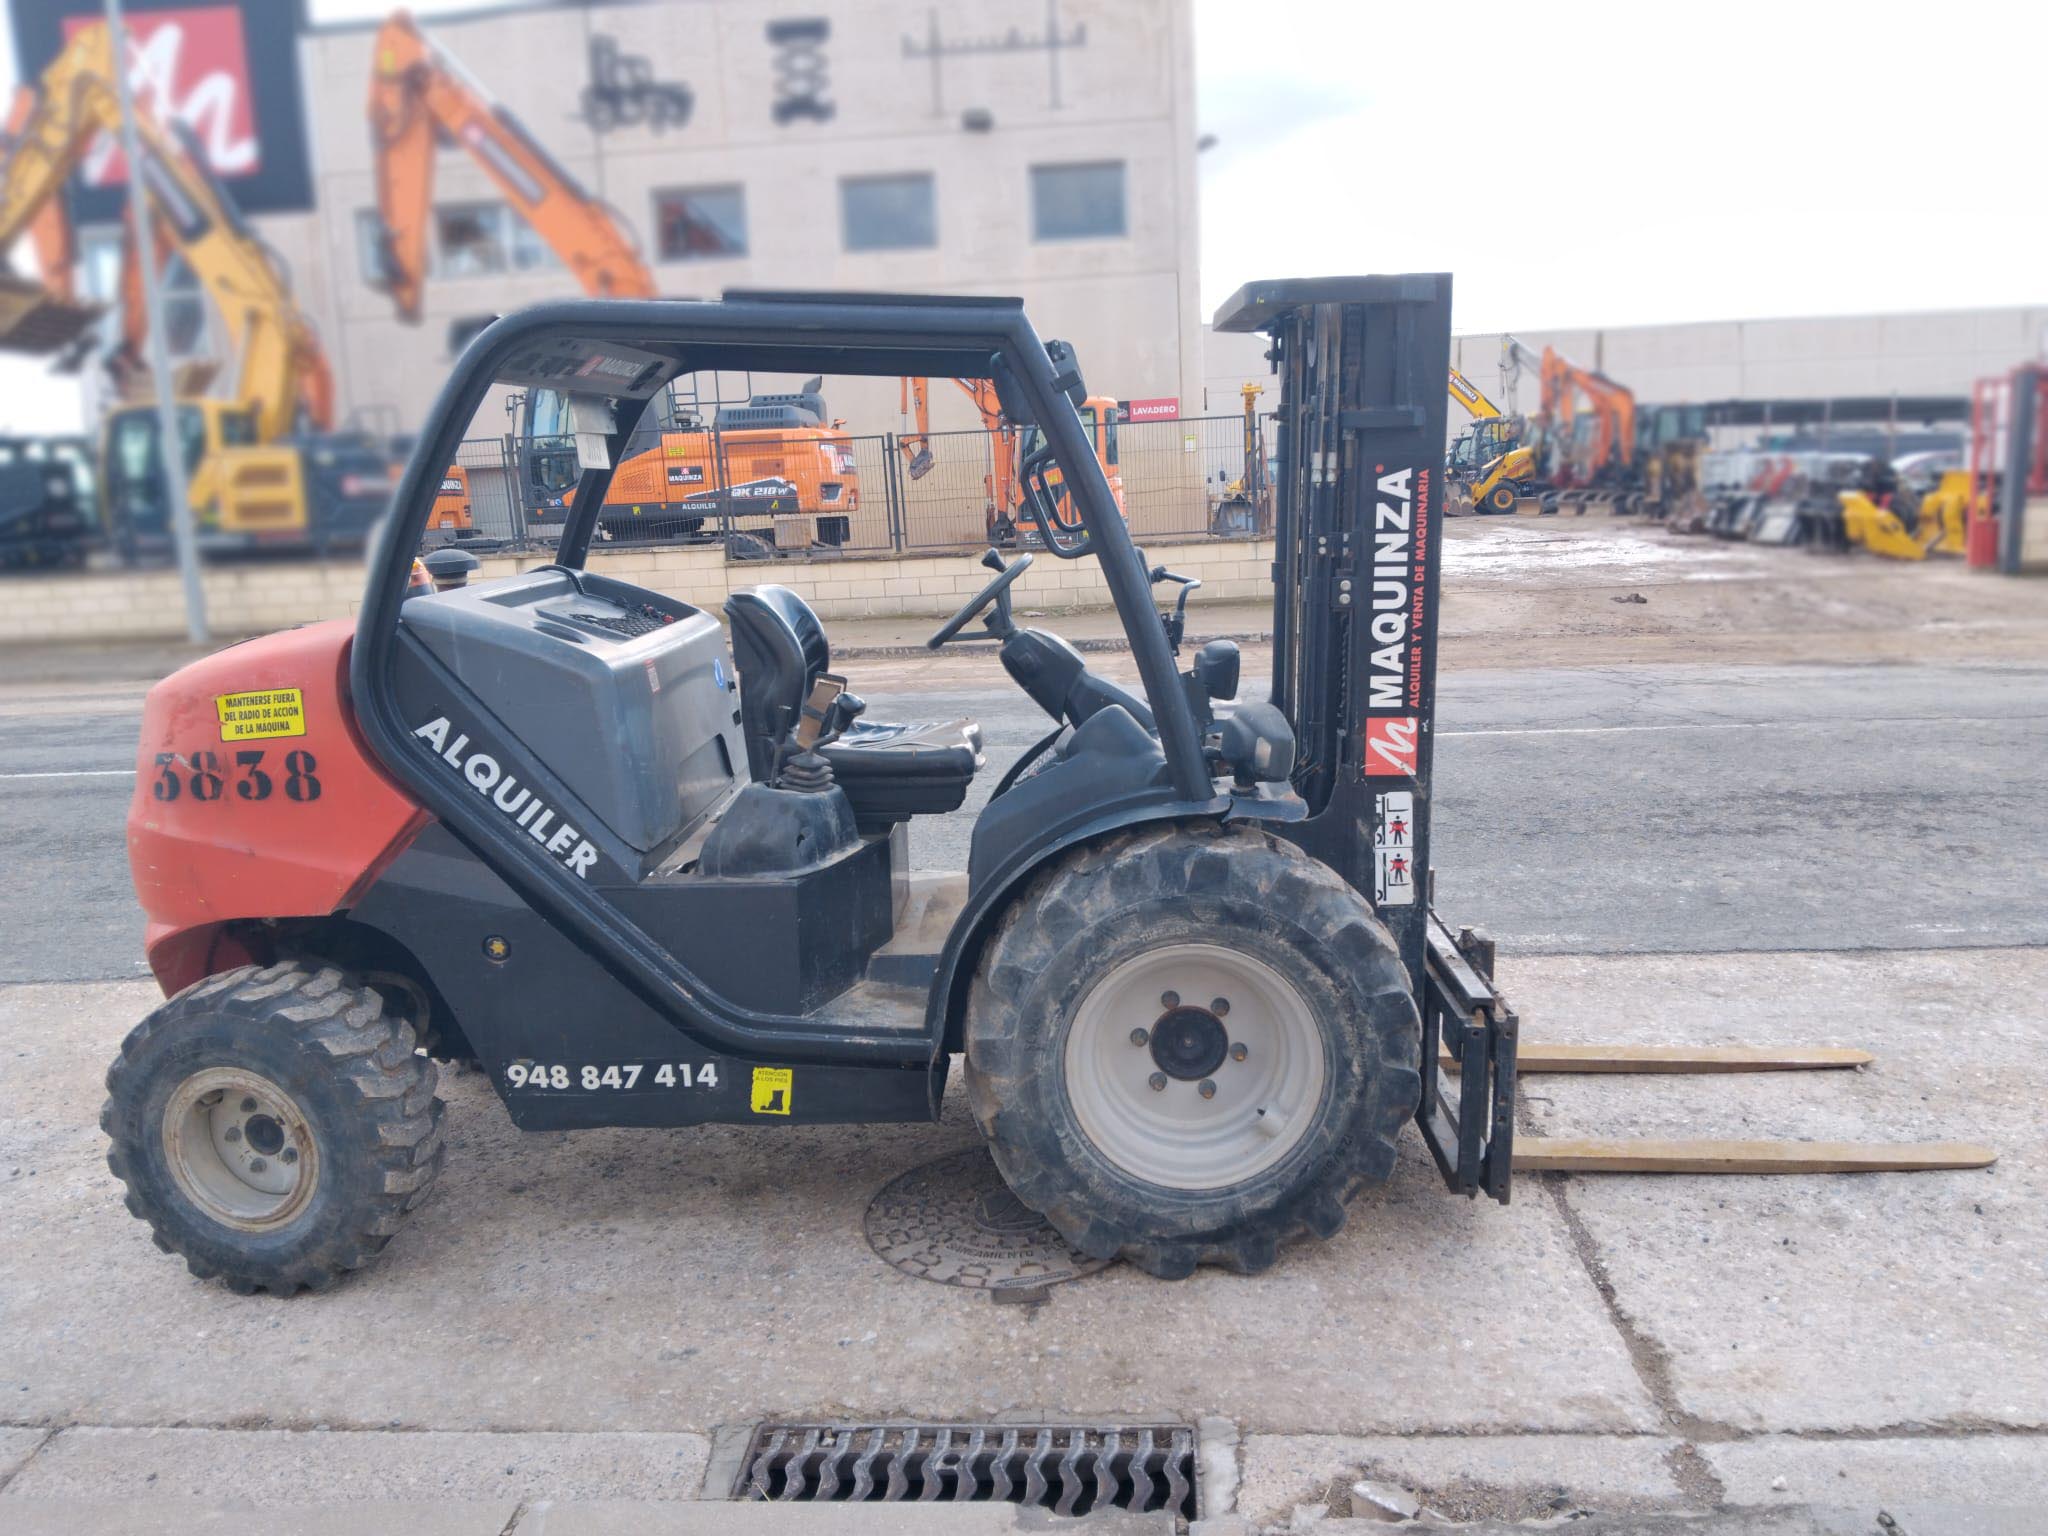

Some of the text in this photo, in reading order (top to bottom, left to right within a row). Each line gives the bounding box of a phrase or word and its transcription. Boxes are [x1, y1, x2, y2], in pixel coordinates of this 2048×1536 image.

[1133, 405, 1176, 415] LAVADERO
[1369, 467, 1412, 708] MAQUINZA
[1408, 468, 1430, 708] ALQUILER Y VENTA DE MAQUINARIA
[226, 693, 295, 708] MANTENERSE FUERA
[224, 712, 236, 721] DEL
[239, 710, 260, 720] RADIO
[262, 708, 271, 718] DE
[235, 725, 243, 734] DE
[246, 723, 254, 733] LA
[414, 717, 598, 879] ALQUILER
[507, 1063, 718, 1089] 948 847 414
